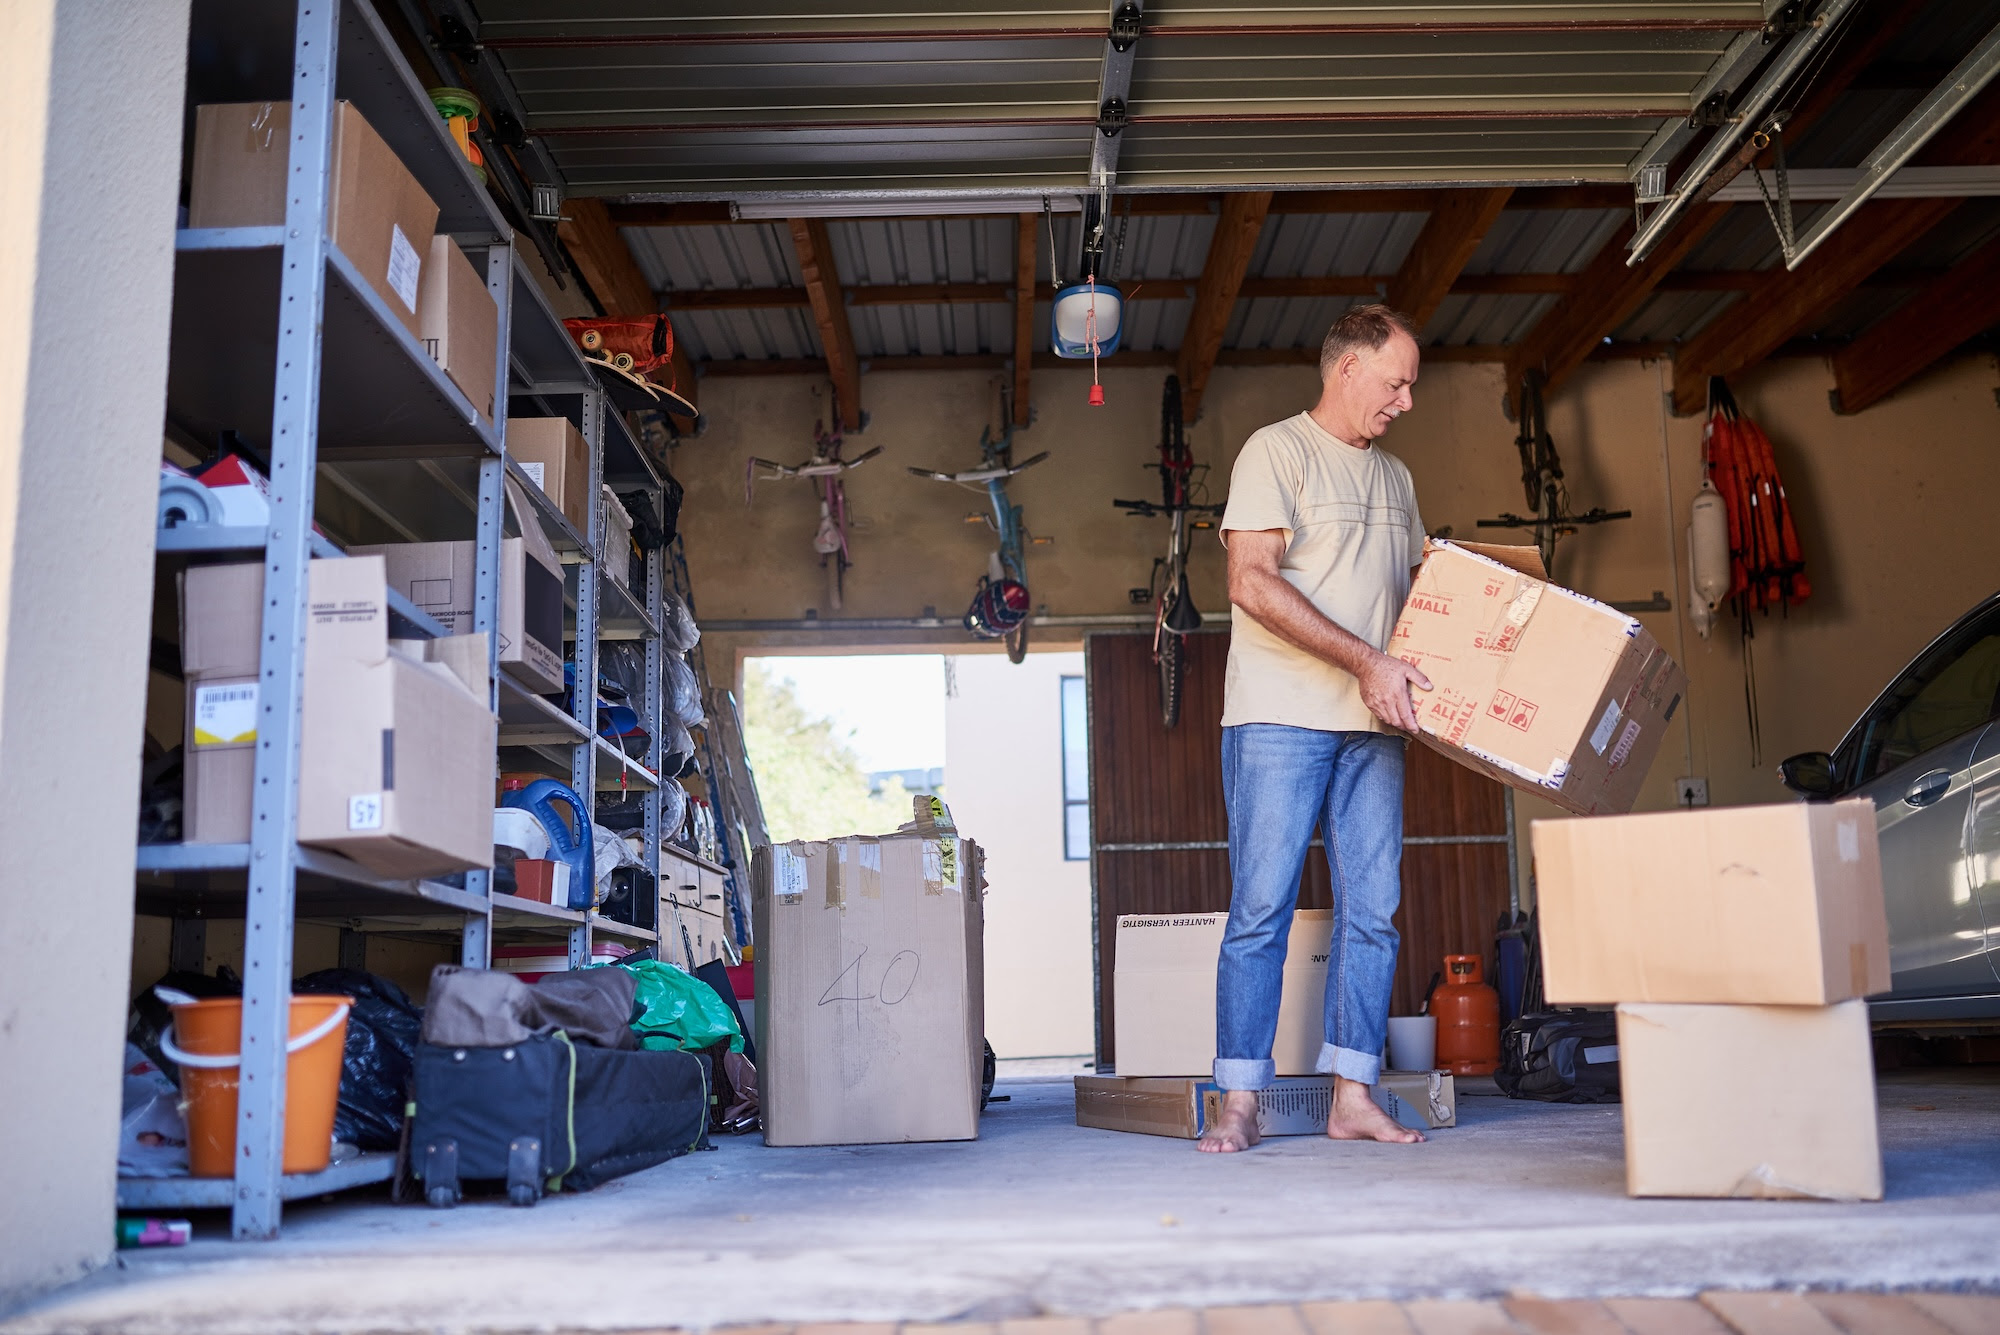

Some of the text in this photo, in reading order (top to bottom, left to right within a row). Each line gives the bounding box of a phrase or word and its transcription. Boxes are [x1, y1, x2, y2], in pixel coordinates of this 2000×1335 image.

[1122, 917, 1216, 928] HANTEER VERSIGTIG
[817, 944, 921, 1031] 40
